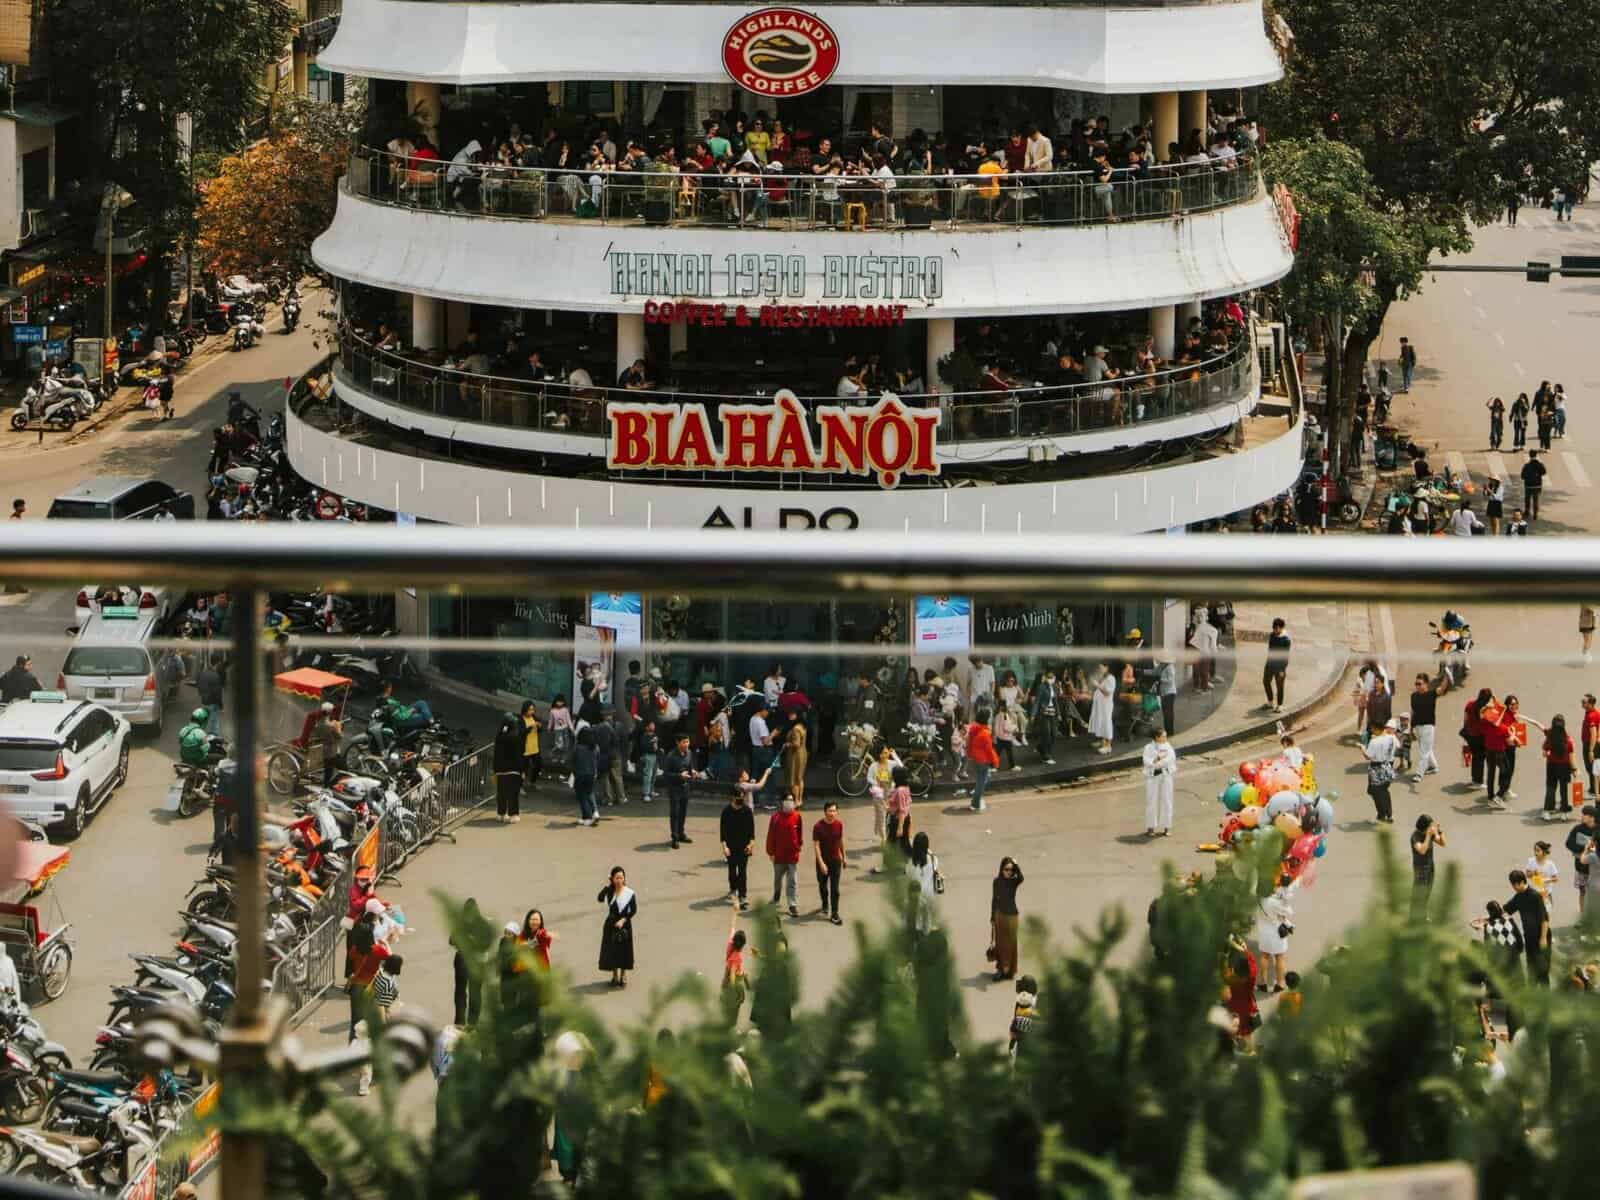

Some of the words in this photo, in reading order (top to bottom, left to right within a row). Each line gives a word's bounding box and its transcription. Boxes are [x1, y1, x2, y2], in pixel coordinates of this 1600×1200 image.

[729, 15, 832, 51] HIGHLANDS
[742, 71, 821, 93] COFFEE
[609, 252, 713, 297] HANOI
[725, 253, 807, 298] 1930
[823, 255, 944, 299] BISTRO
[643, 301, 728, 328] COFFEE
[735, 305, 751, 327] &
[760, 304, 908, 328] RESTAURANT
[608, 403, 717, 470] BIA
[720, 392, 815, 471] HÀ
[818, 394, 940, 488] NỘI
